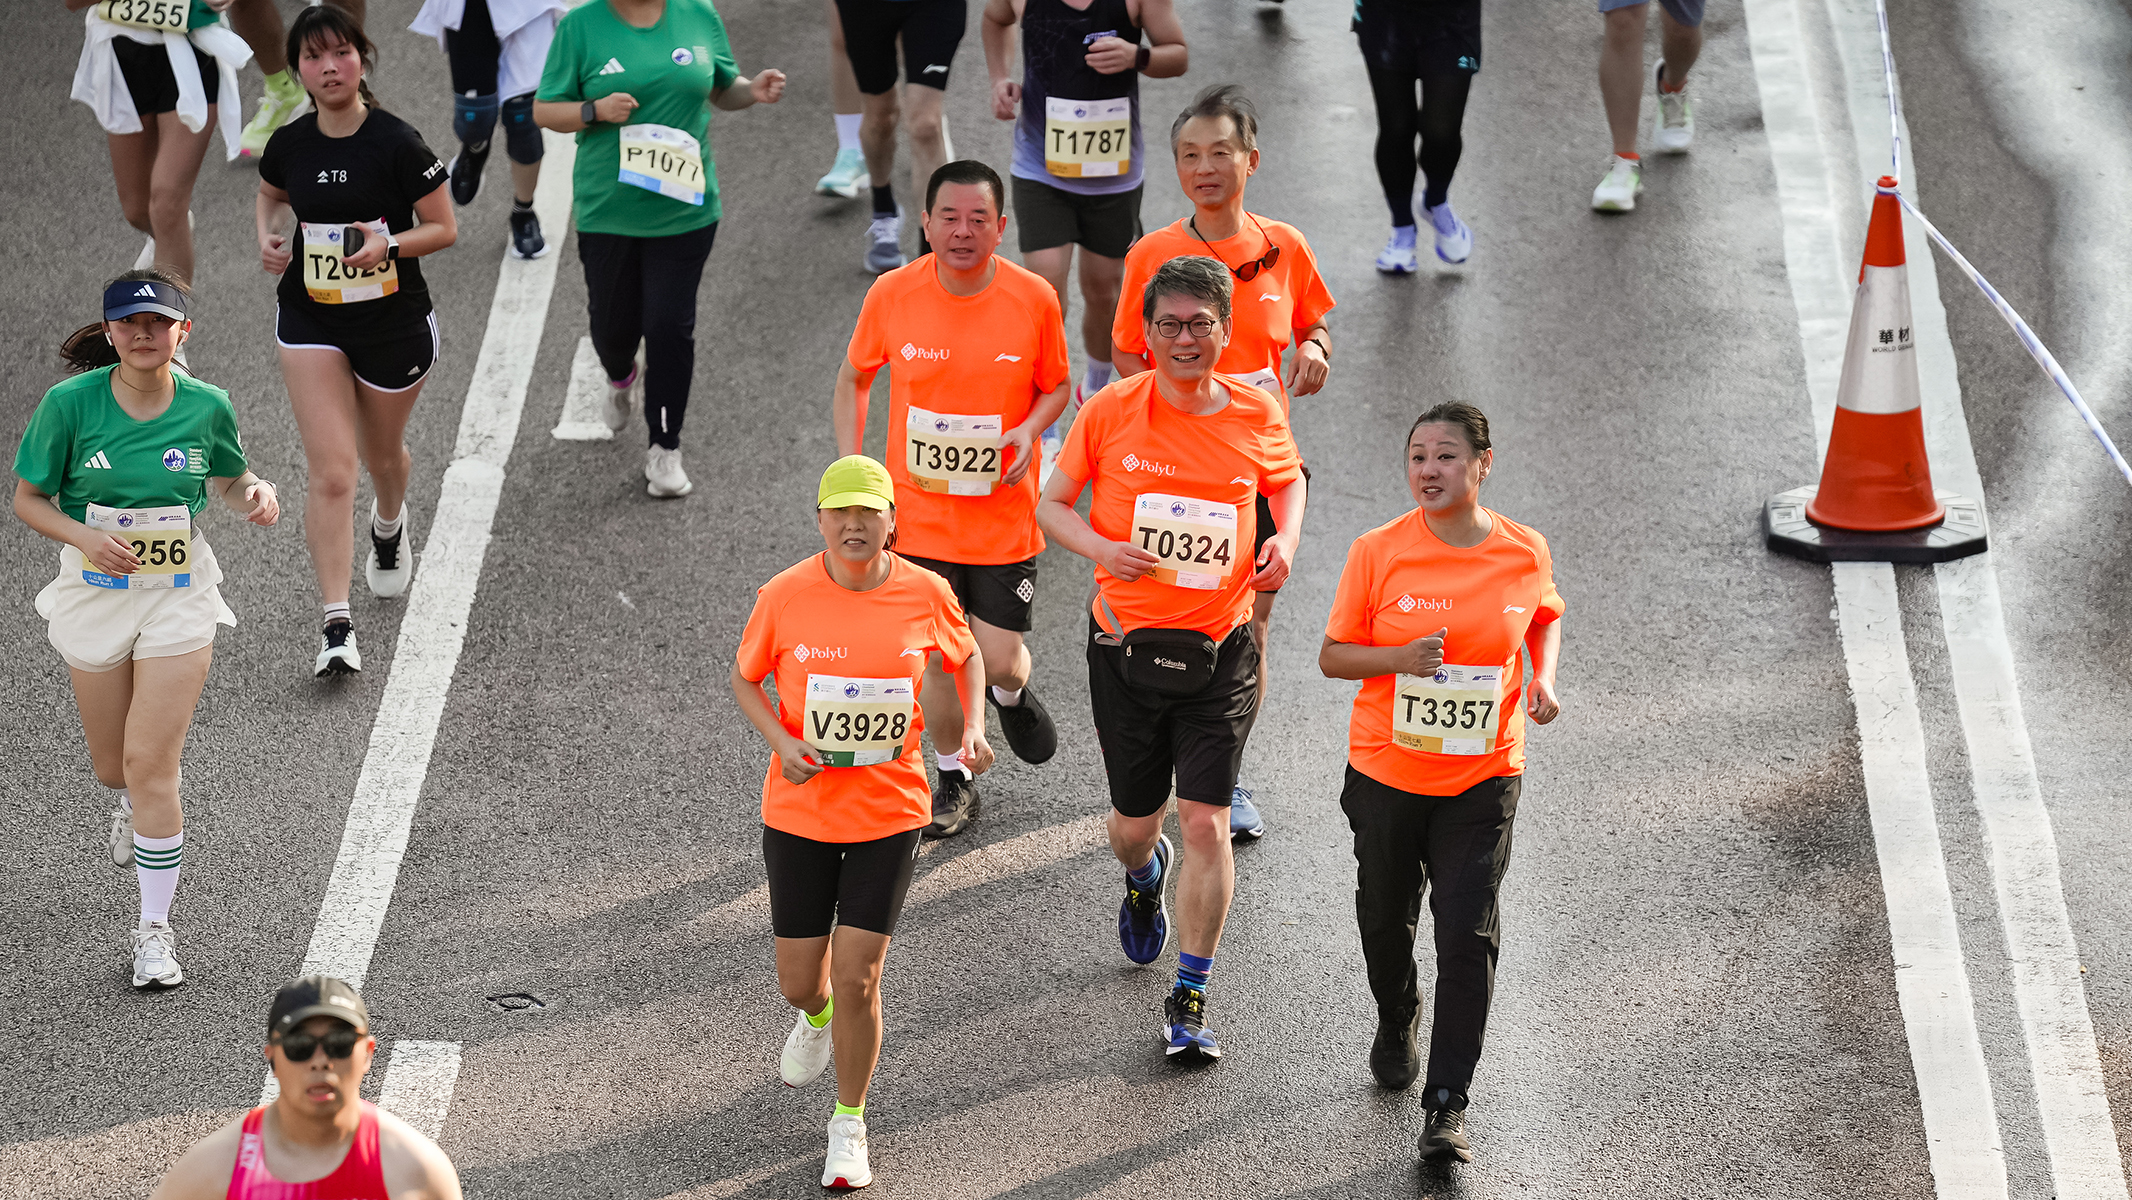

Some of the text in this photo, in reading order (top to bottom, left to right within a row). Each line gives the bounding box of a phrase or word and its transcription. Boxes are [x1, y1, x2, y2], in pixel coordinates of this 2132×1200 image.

[107, 0, 183, 27] T3255
[1052, 128, 1126, 154] T1787
[331, 170, 347, 183] T8
[627, 147, 699, 181] P1077
[917, 347, 950, 362] PolyU
[1872, 345, 1896, 353] WORLD
[911, 439, 996, 472] T3922
[1140, 459, 1176, 477] PolyU
[130, 538, 187, 566] 256
[1138, 526, 1230, 566] T0324
[1417, 599, 1452, 612] PolyU
[811, 647, 848, 661] PolyU
[1401, 694, 1494, 729] T3357
[811, 710, 906, 741] V3928
